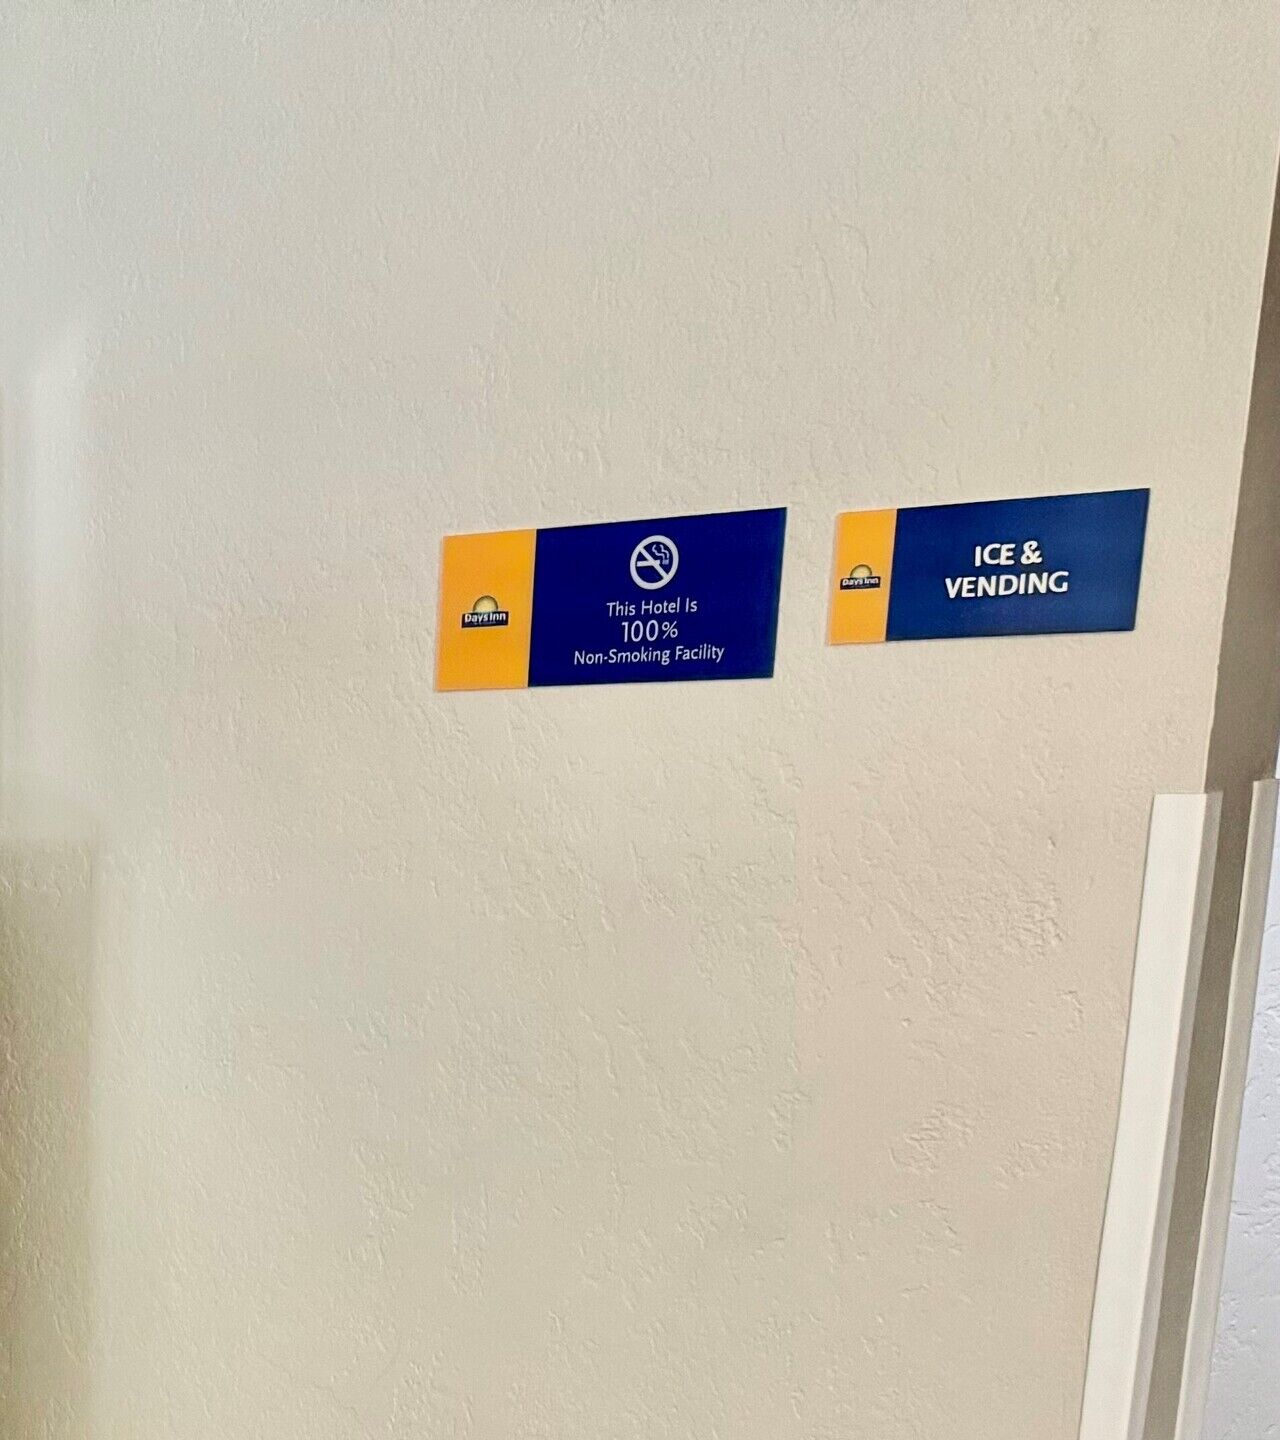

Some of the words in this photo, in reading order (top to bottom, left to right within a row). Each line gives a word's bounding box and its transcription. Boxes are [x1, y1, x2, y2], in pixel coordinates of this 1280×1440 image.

[974, 543, 1015, 567] ICE
[1020, 540, 1043, 565] &
[945, 570, 1069, 599] VENDING
[465, 613, 489, 623] Days
[490, 612, 506, 621] Inn
[607, 600, 636, 616] This
[641, 597, 681, 615] Hotel
[685, 598, 698, 613] Is
[622, 620, 678, 643] 100%
[573, 647, 671, 666] Non-Smoking
[675, 643, 725, 663] Facility
